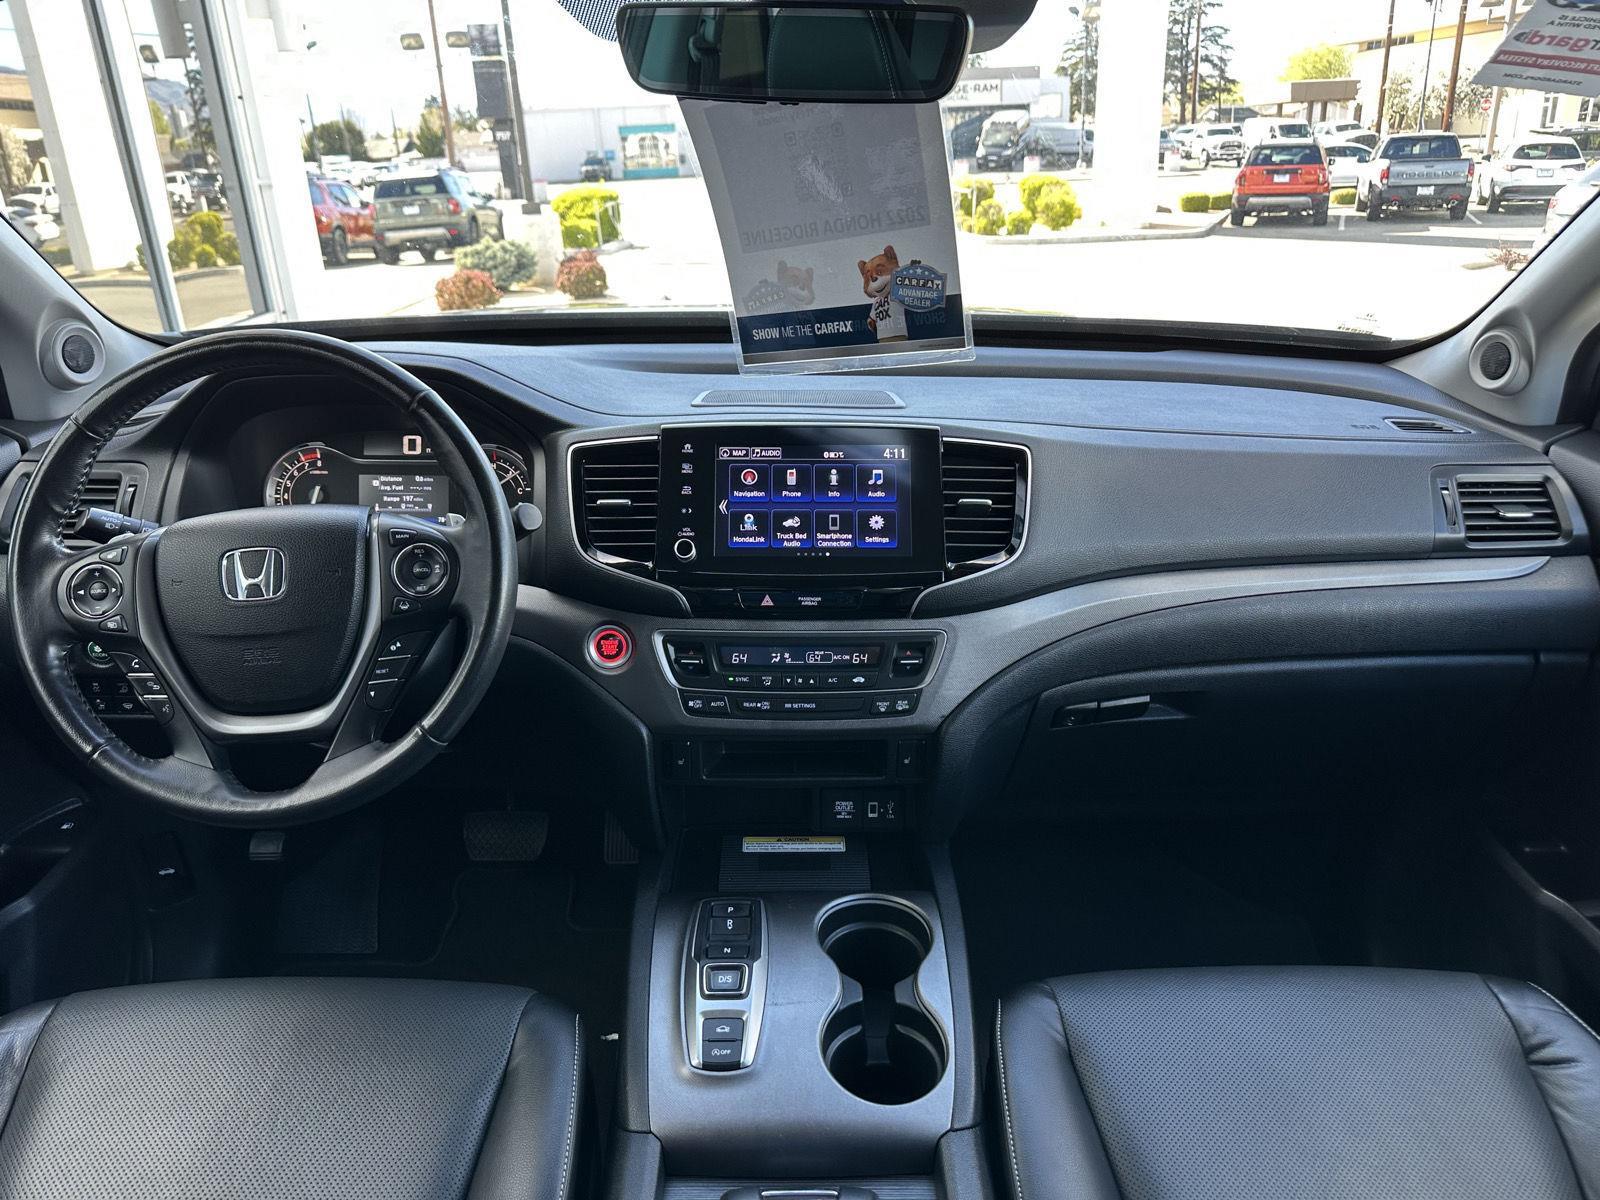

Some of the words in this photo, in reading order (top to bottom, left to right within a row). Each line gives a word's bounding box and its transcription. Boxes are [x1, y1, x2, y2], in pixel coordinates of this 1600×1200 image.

[896, 276, 942, 290] CARFAX
[898, 288, 938, 299] ADVANTAGE
[904, 297, 931, 307] DEALER
[875, 307, 892, 322] FOX
[752, 327, 779, 341] SHOW
[781, 325, 795, 338] ME
[795, 323, 813, 336] THE
[814, 320, 853, 335] CARFAX
[402, 435, 422, 455] 0
[883, 448, 905, 459] 4:11
[293, 469, 299, 477] 6
[286, 480, 291, 488] 5
[517, 487, 523, 495] C
[733, 490, 766, 498] Navigation
[733, 535, 765, 543] HondaLink
[776, 532, 794, 540] Truck
[795, 532, 807, 540] Bed
[816, 532, 852, 541] Smartphone
[865, 536, 890, 544] Settings
[783, 540, 801, 548] Audio
[731, 653, 748, 664] 64
[808, 654, 821, 662] 64
[852, 653, 868, 664] 64
[727, 919, 733, 927] R
[718, 975, 732, 983] D/S
